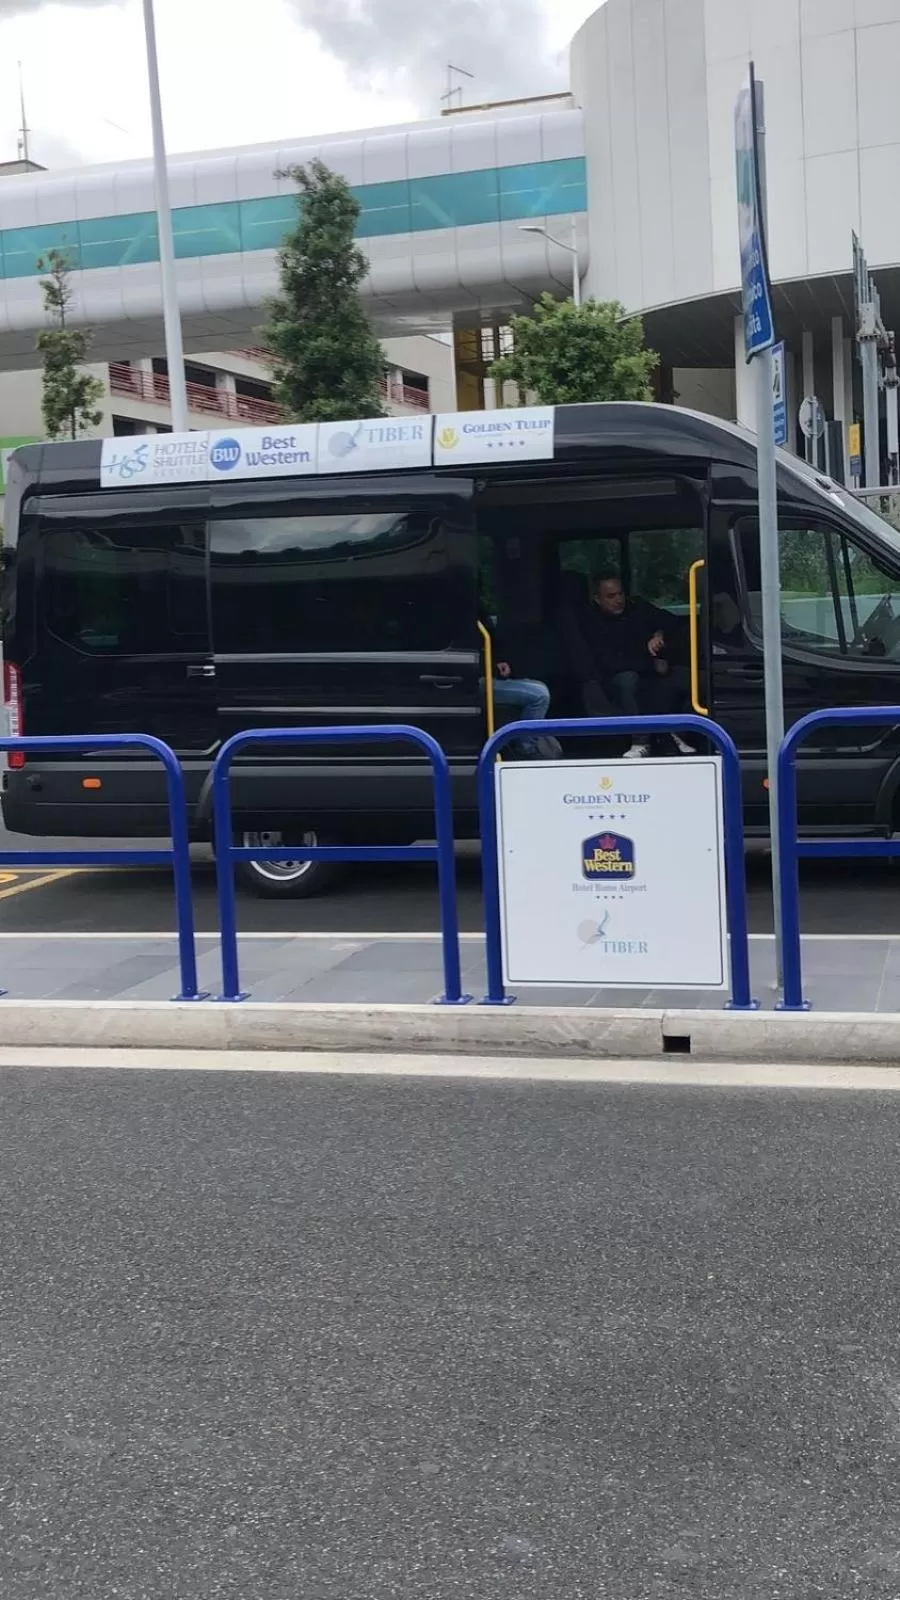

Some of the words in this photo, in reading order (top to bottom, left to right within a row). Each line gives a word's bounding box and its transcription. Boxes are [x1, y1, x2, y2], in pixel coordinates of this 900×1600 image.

[462, 422, 512, 434] GOLDEN
[516, 419, 551, 431] TULIP
[363, 424, 424, 444] TIBER
[154, 440, 208, 455] HOTELS
[261, 436, 297, 450] Best
[154, 454, 205, 468] SHUTTLE
[212, 447, 241, 463] BW
[245, 451, 310, 467] Western
[562, 794, 612, 805] GOLDEN
[614, 793, 651, 804] TULIP
[592, 848, 622, 861] Best
[583, 859, 633, 872] Western
[619, 883, 647, 894] Airport
[601, 941, 648, 954] TIBER
